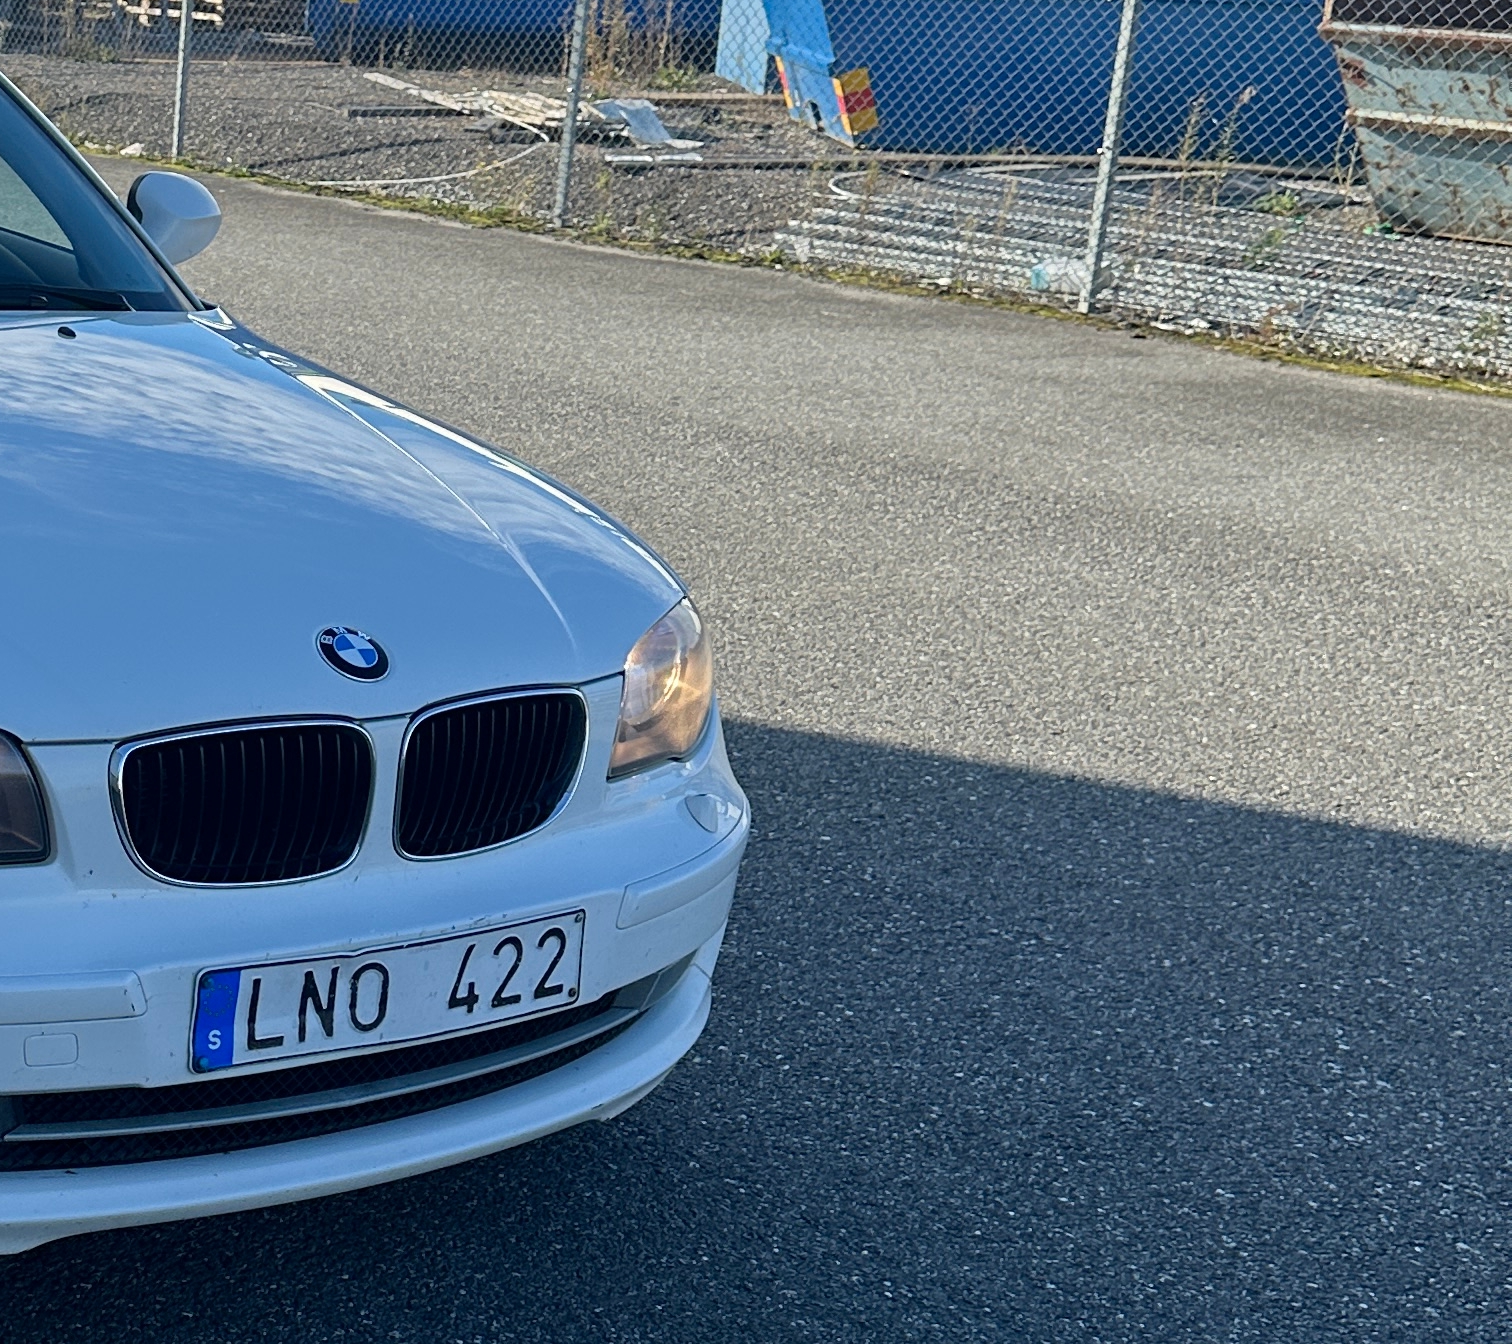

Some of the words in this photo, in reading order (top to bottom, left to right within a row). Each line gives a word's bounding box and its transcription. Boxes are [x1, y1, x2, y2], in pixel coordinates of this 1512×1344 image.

[247, 961, 389, 1050] LNO
[448, 927, 567, 1014] 422
[207, 1029, 222, 1050] S
